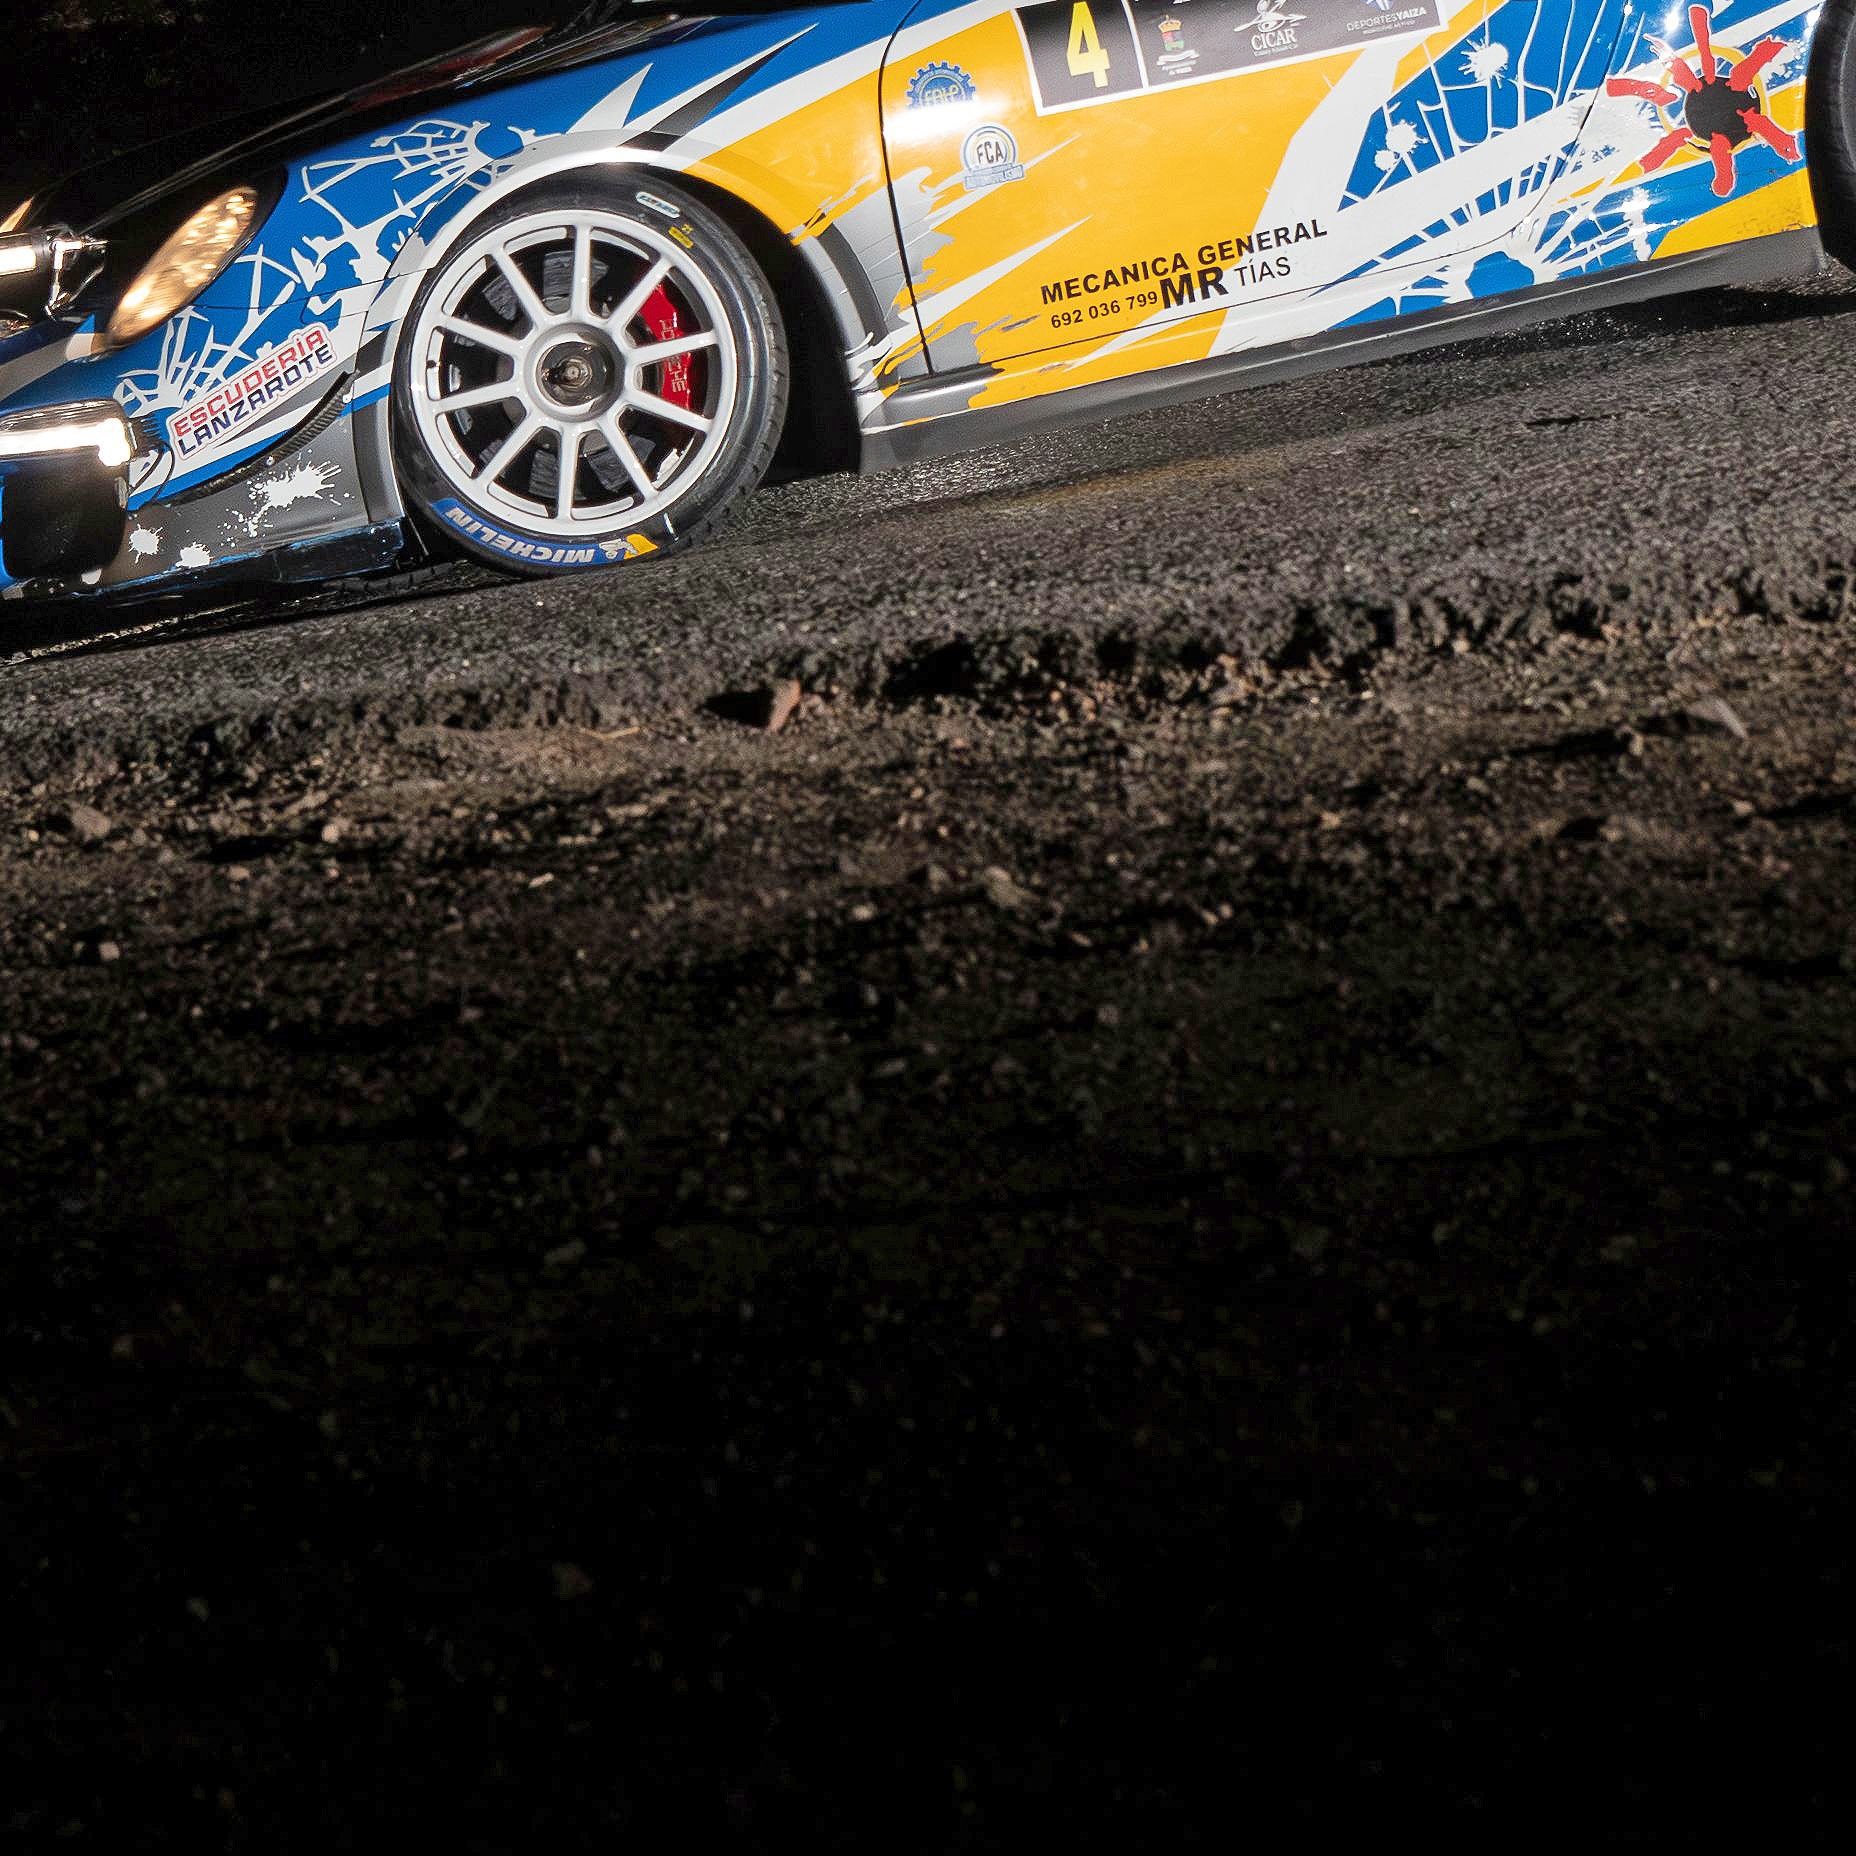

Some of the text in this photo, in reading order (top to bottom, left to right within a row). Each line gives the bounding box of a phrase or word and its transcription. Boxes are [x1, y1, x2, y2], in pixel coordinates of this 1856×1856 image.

[1066, 1, 1111, 88] 4
[1251, 28, 1297, 51] CICAR
[976, 141, 1004, 164] FCA
[1040, 219, 1328, 305] MECANICA GENERAL
[1233, 256, 1292, 287] TÍAS
[1050, 291, 1158, 329] 692 036 799
[1159, 266, 1229, 310] MR
[178, 343, 333, 456] LANZAROTE
[445, 506, 595, 564] MICHELIN
